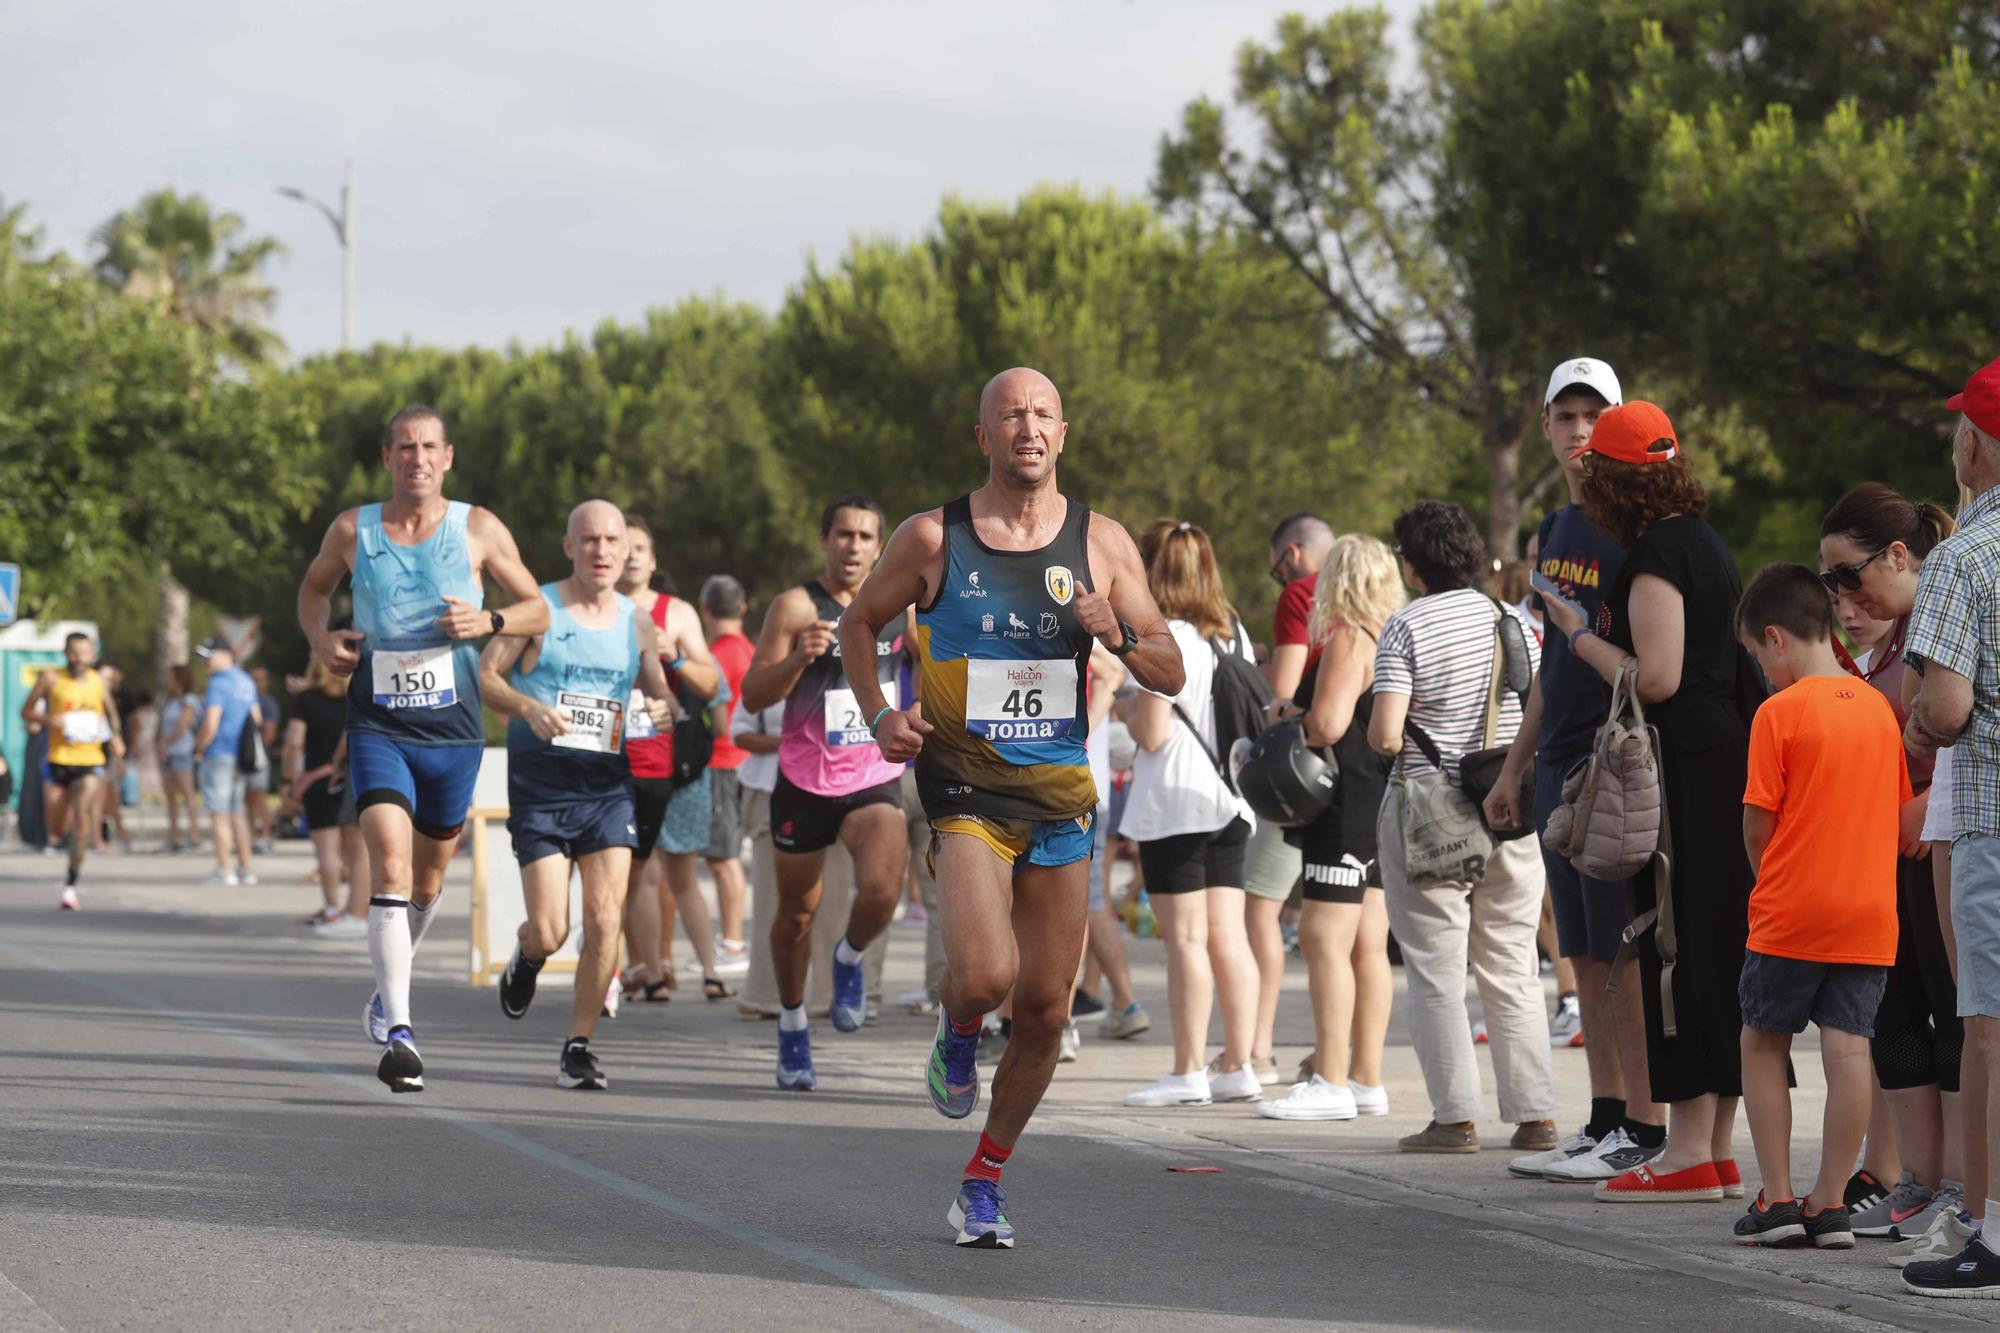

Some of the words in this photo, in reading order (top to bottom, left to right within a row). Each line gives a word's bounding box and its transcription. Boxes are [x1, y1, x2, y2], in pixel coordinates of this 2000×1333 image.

[391, 671, 435, 693] 150
[1002, 689, 1043, 718] 46
[571, 709, 605, 728] 1962
[1411, 838, 1470, 864] GERMANY
[1305, 863, 1360, 888] PUMA
